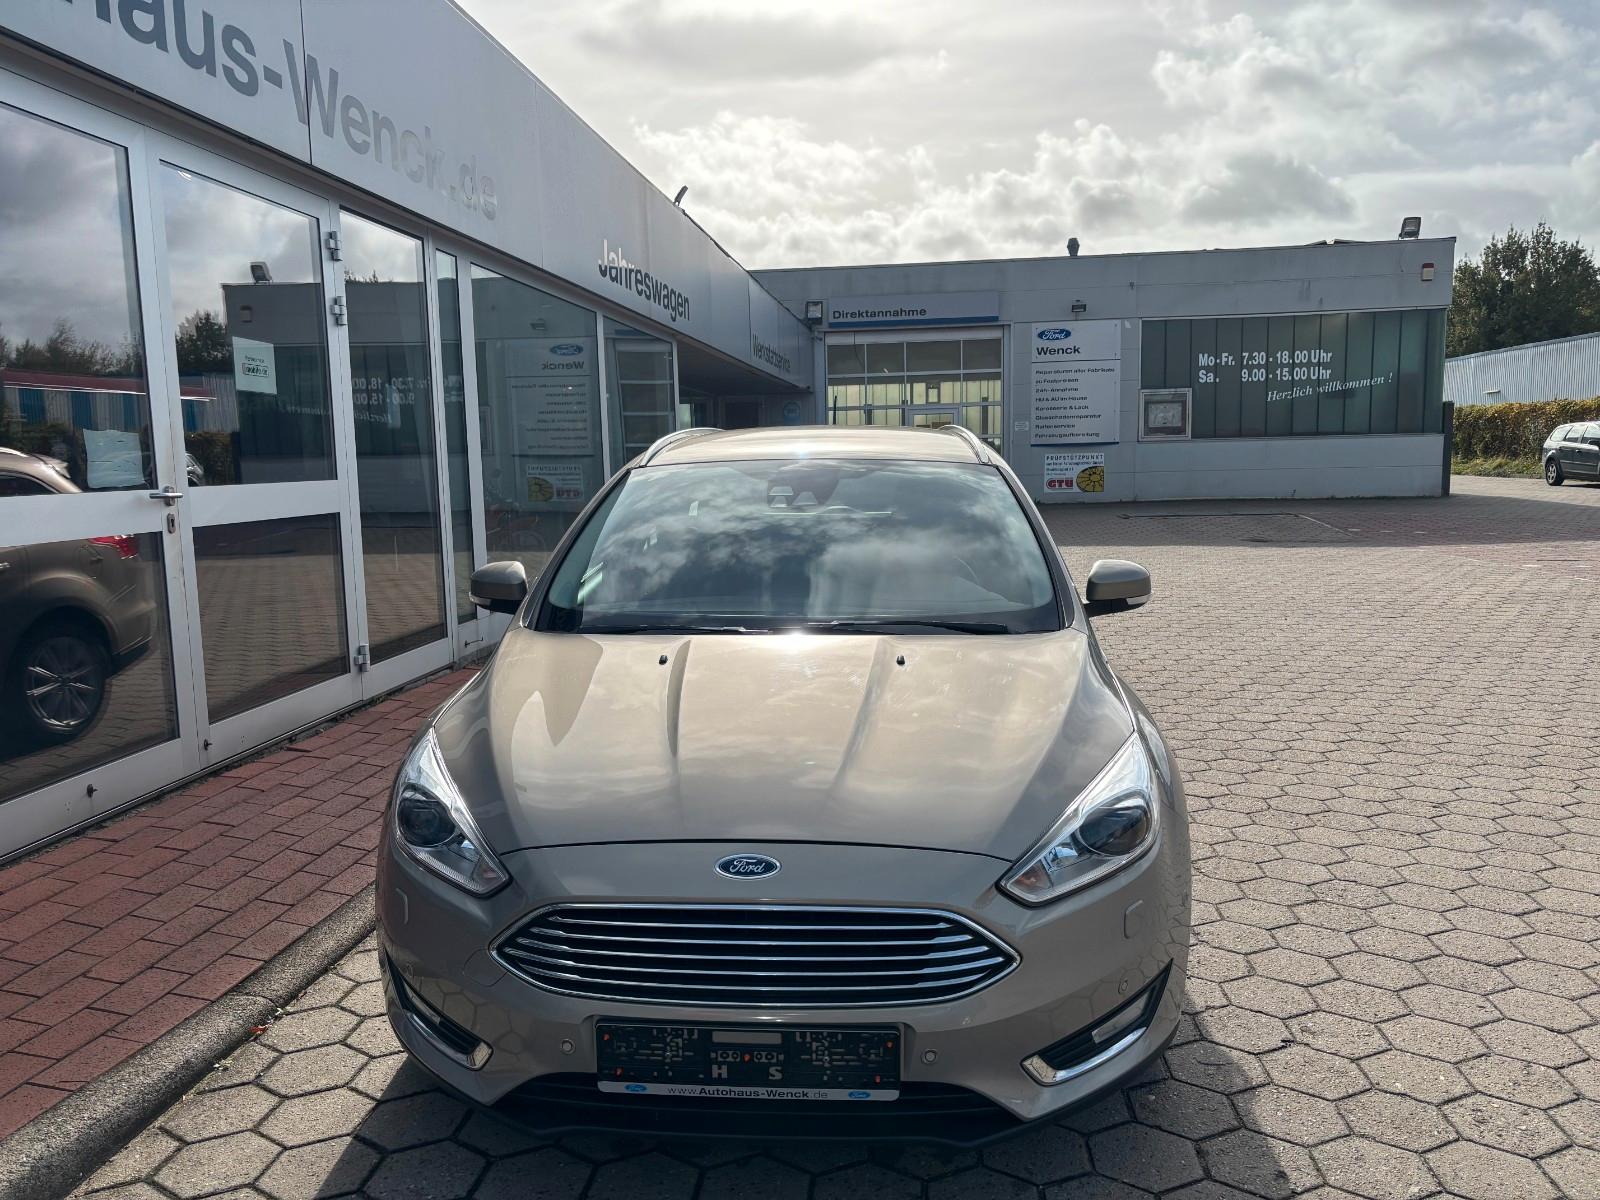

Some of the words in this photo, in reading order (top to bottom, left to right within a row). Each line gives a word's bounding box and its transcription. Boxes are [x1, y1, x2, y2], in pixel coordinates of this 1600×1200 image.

[61, 0, 497, 221] aus-Wenck.de
[598, 239, 691, 322] Jahreswagen
[832, 307, 927, 320] Direktannahme
[1041, 329, 1068, 340] Ford
[1036, 345, 1081, 356] Wenck
[1242, 351, 1267, 366] 7.30
[1276, 350, 1309, 364] 18.00
[1311, 349, 1333, 363] Uhr
[1198, 369, 1220, 383] Sa.
[1241, 368, 1266, 382] 9.00
[1275, 368, 1308, 381] 15.00
[1310, 366, 1332, 380] Uhr
[1266, 385, 1313, 402] Herzlich
[1316, 376, 1385, 393] willkommen
[729, 858, 766, 873] Ford
[667, 1086, 828, 1099] www.Autohaus-Wenck.de
